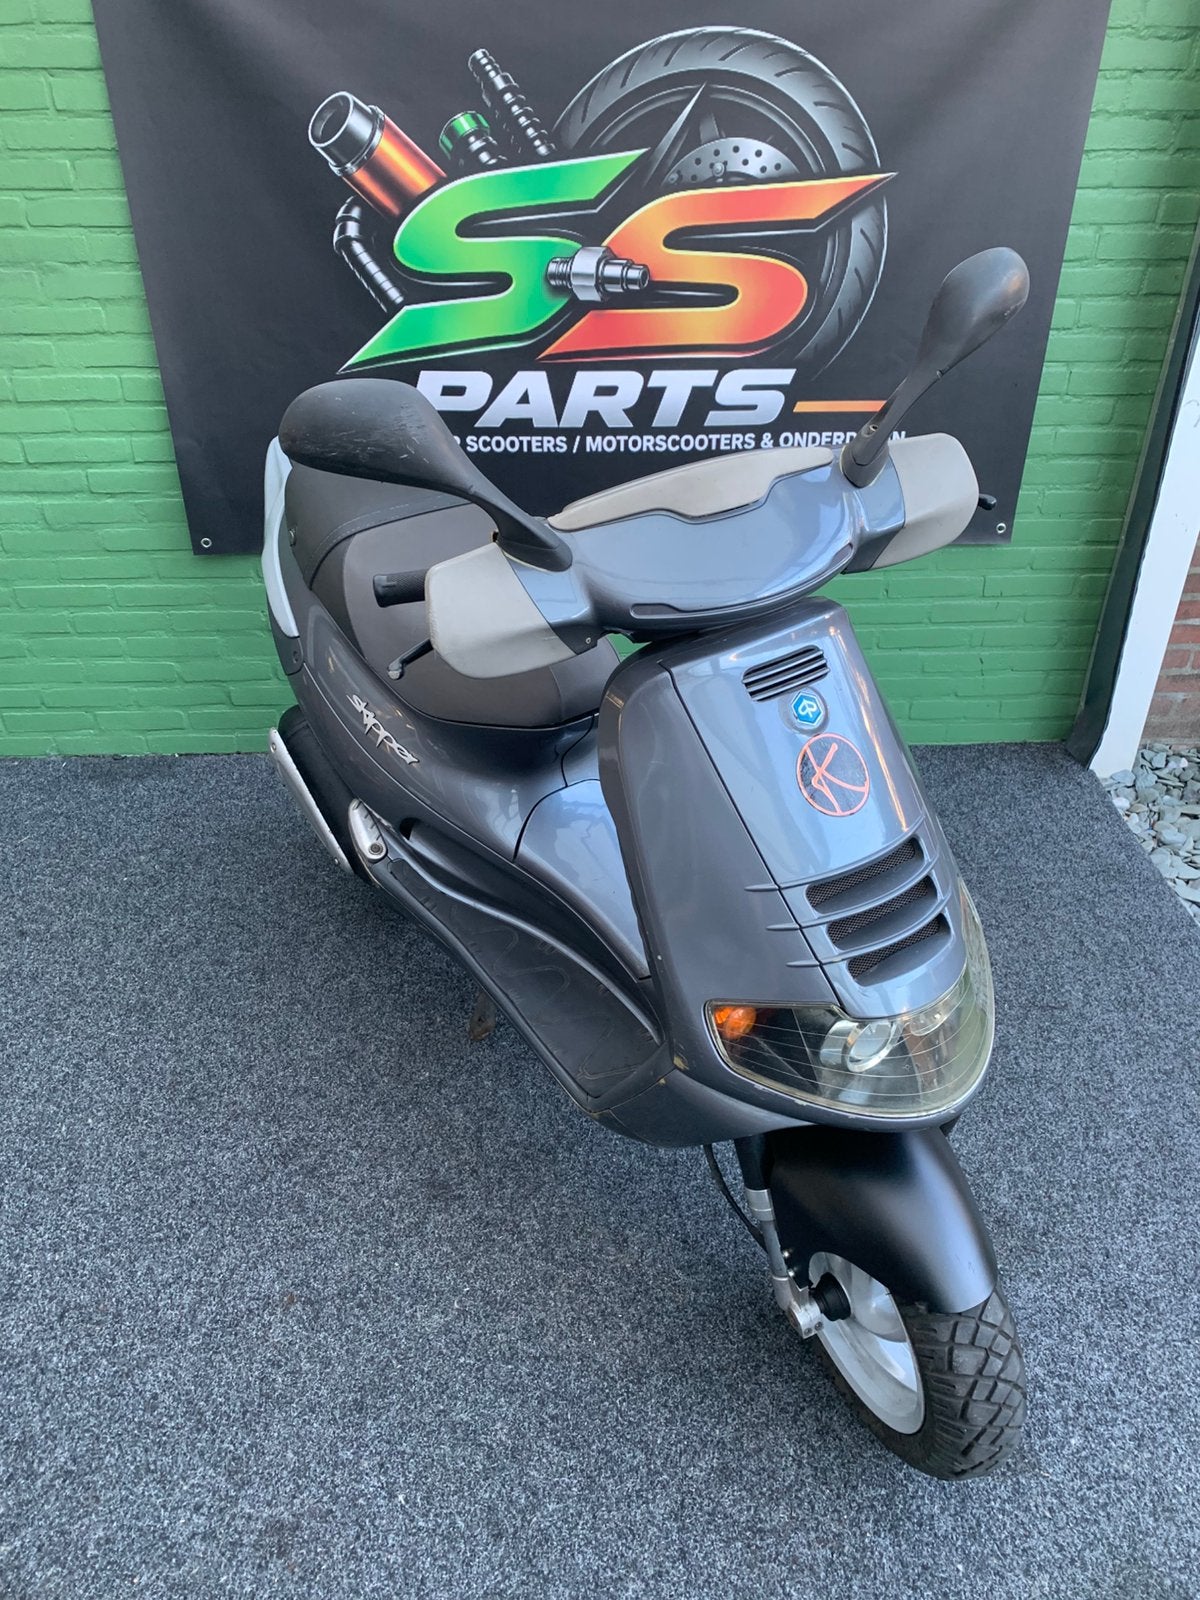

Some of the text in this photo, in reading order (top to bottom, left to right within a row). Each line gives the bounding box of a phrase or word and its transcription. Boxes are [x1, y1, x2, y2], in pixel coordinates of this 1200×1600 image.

[339, 148, 897, 373] SS
[416, 368, 797, 428] PARTS
[466, 435, 568, 453] SCOOTERS
[586, 432, 755, 452] MOTORSCOOTERS
[760, 433, 773, 449] &
